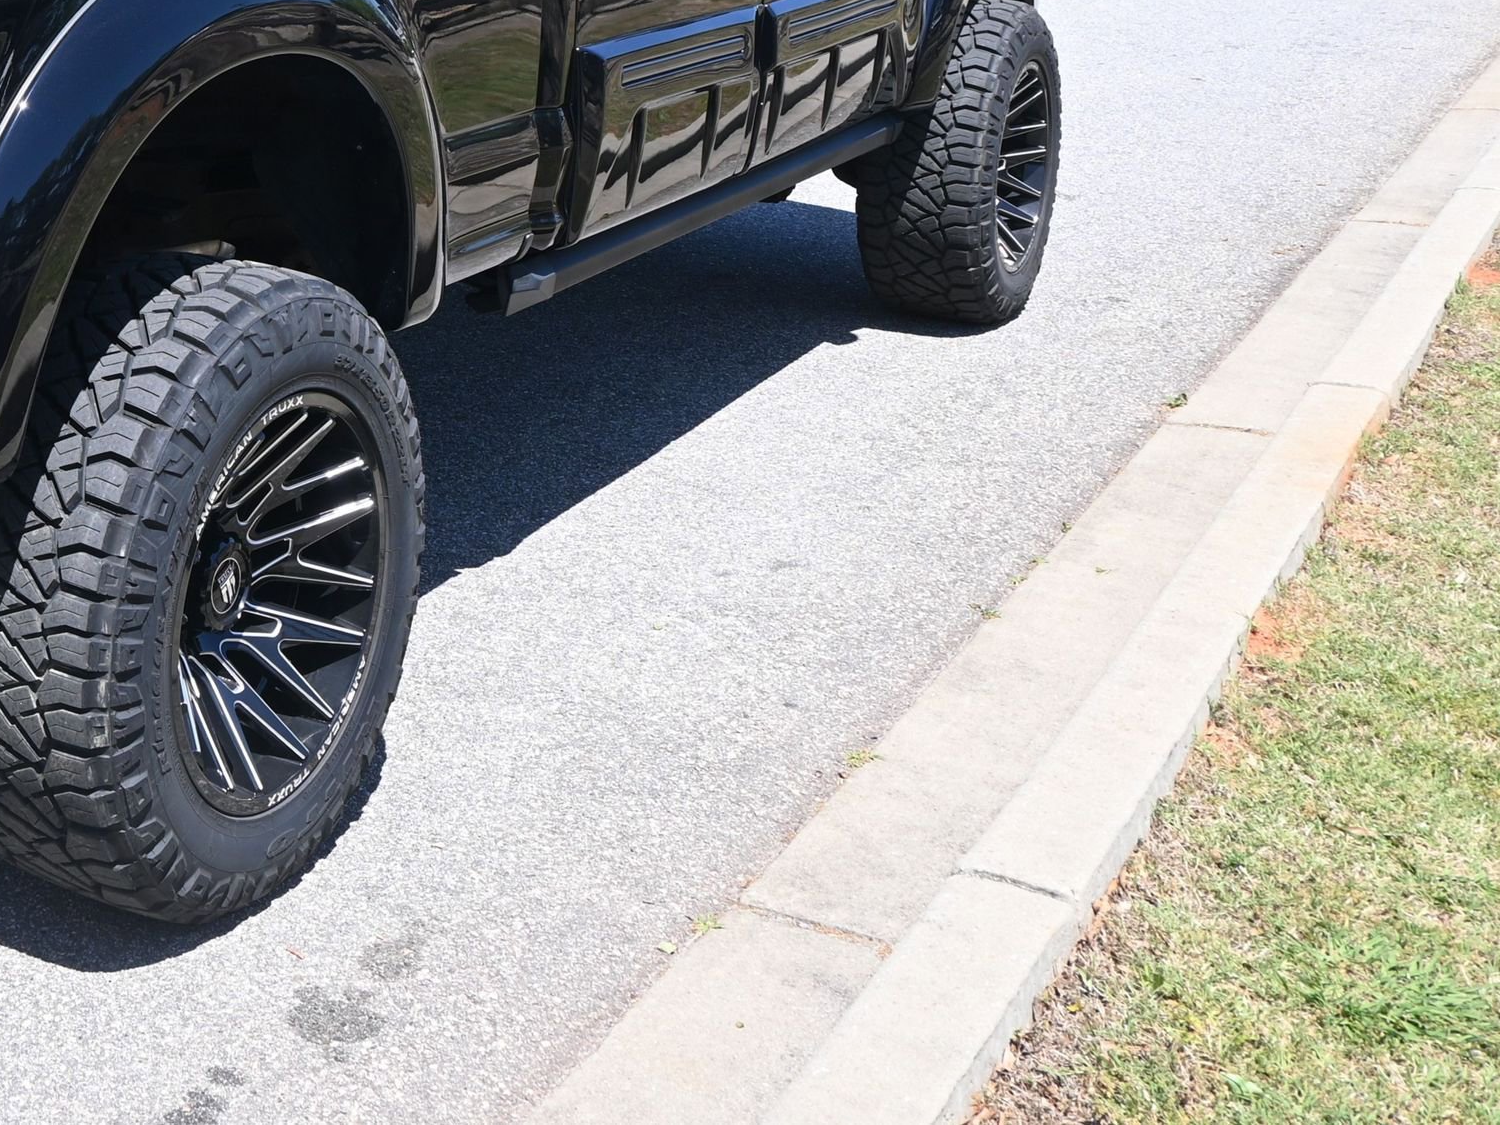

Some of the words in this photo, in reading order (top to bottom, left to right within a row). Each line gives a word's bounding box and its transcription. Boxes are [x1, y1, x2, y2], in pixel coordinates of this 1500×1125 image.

[196, 430, 253, 541] AMERICAN
[260, 394, 304, 425] TRUXX
[317, 654, 366, 760] AMERICAN
[267, 768, 311, 807] TRUXX
